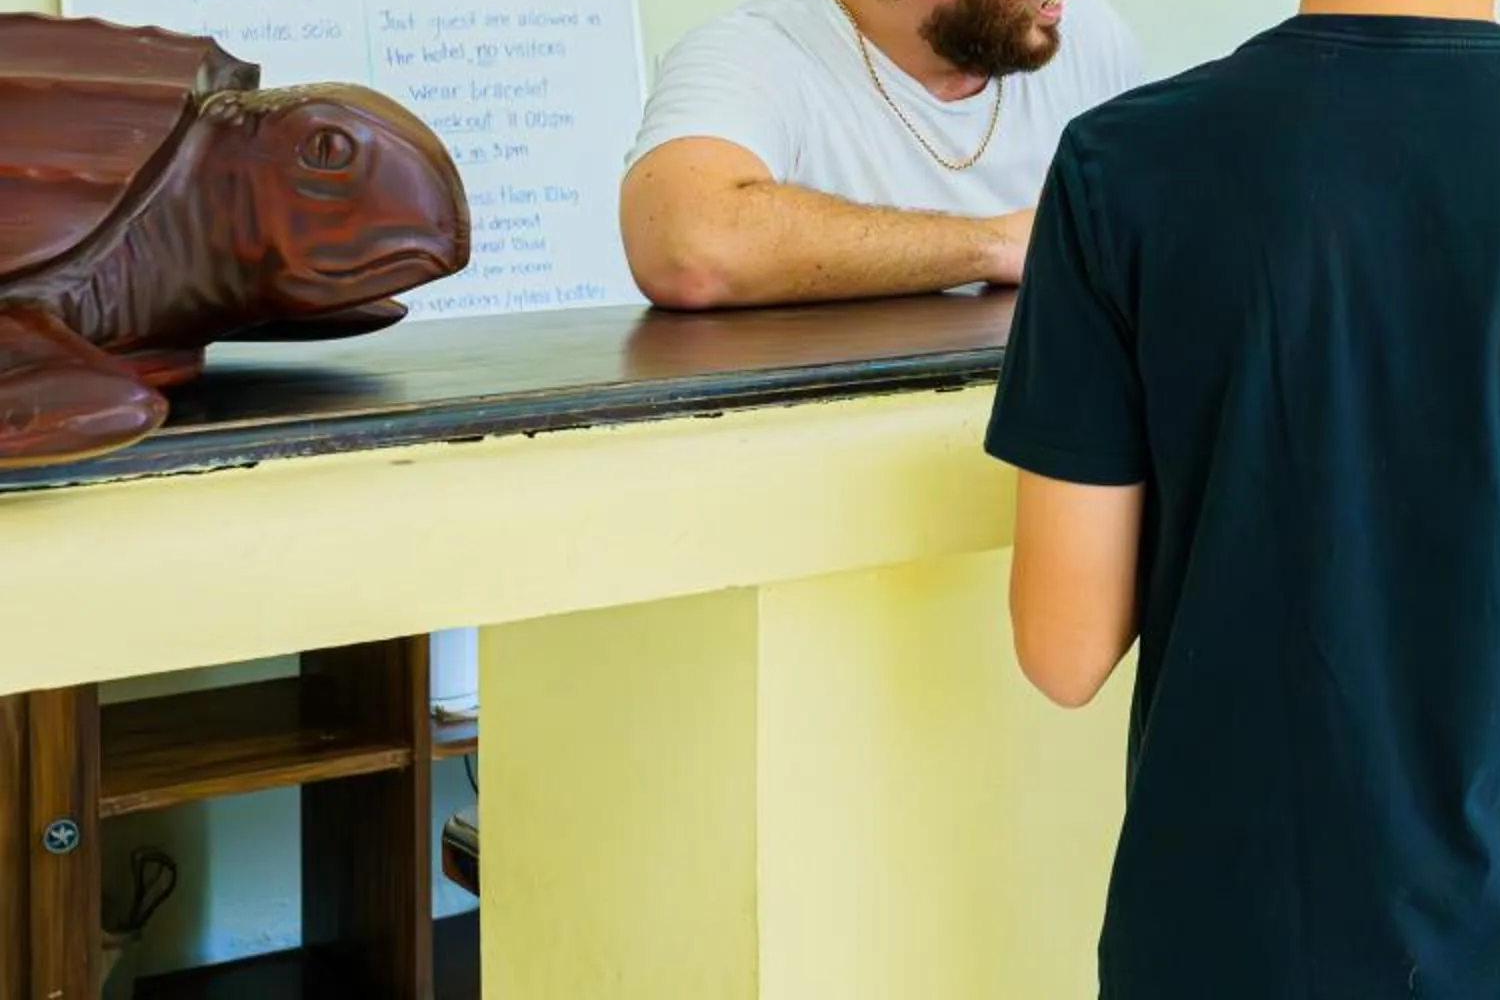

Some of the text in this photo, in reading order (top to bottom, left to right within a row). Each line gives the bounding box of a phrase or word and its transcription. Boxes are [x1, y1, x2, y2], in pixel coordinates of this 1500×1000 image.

[380, 7, 415, 30] Just
[430, 11, 477, 40] guest
[518, 11, 579, 28] allowed
[586, 12, 602, 27] in
[385, 45, 415, 67] the
[477, 42, 499, 60] no
[471, 75, 548, 100] bracelet
